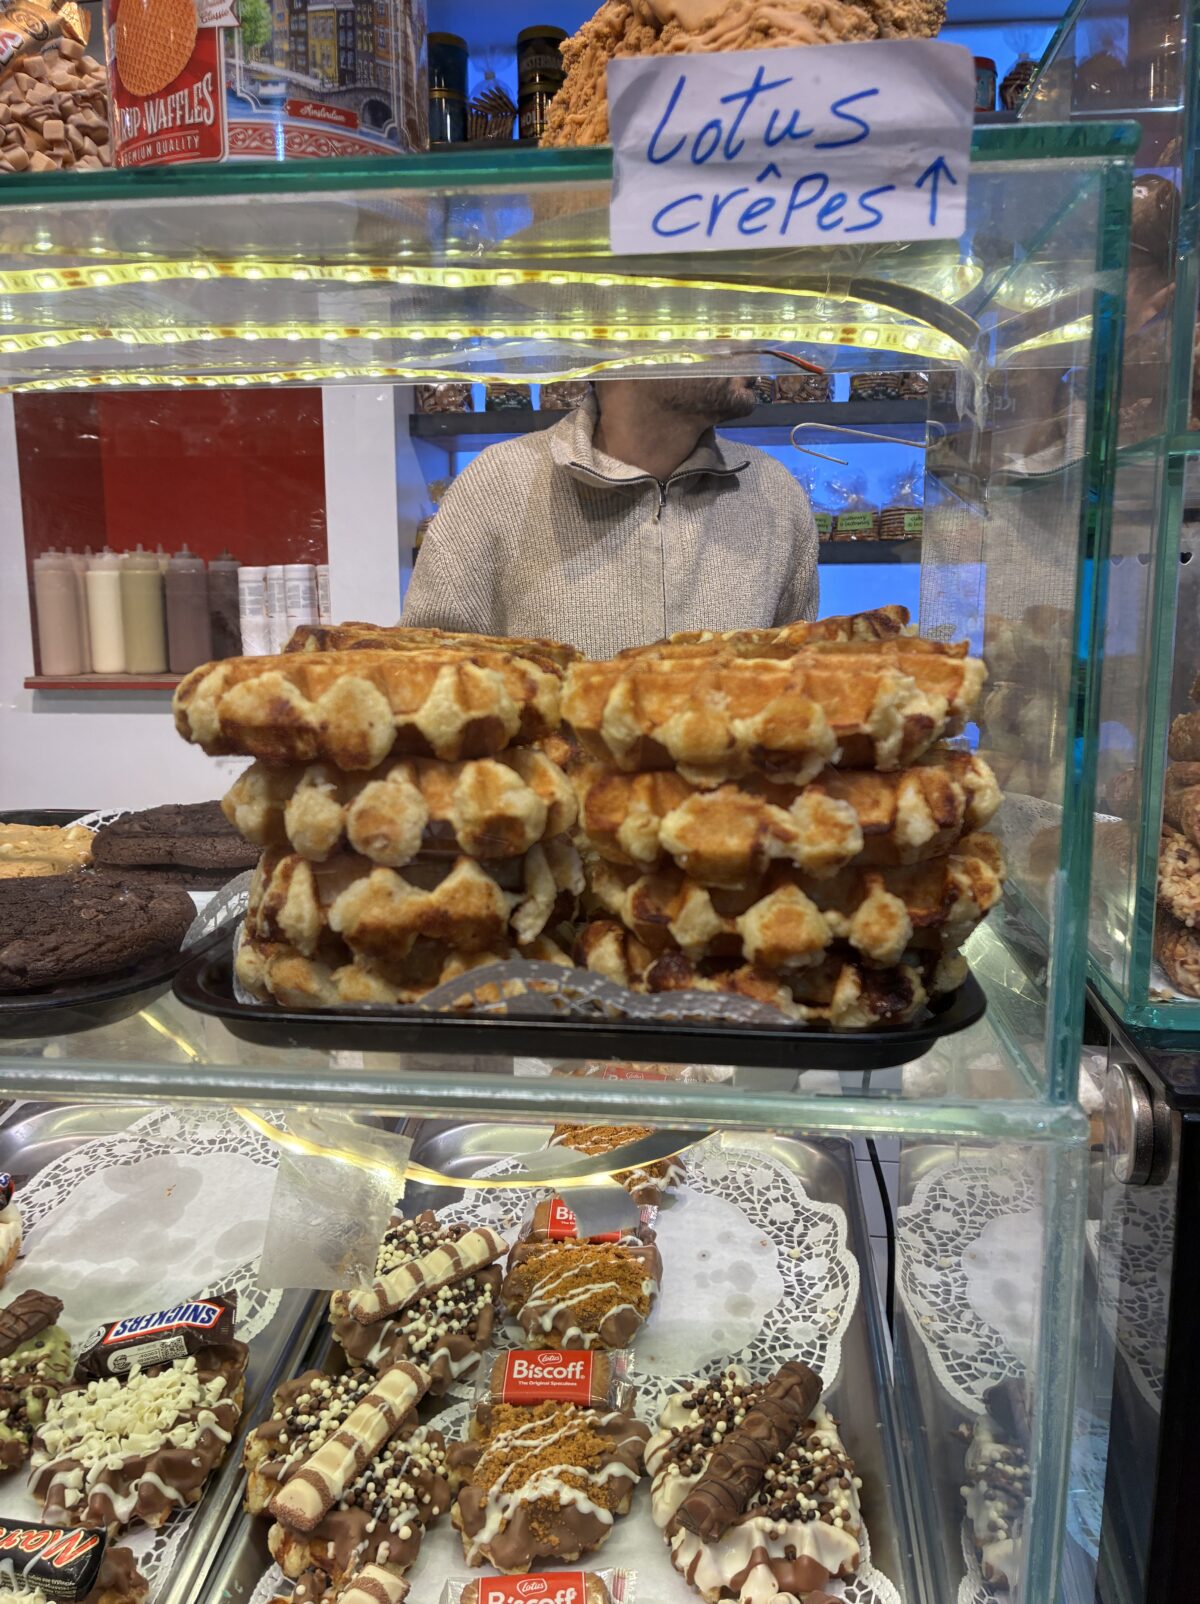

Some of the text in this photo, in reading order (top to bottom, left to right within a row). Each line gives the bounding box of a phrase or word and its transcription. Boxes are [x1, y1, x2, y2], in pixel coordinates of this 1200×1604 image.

[144, 72, 215, 135] WAFFLES
[648, 66, 880, 164] Lotus
[156, 136, 199, 155] QUALITY
[113, 1303, 218, 1337] SNICKERS
[541, 1354, 561, 1363] Lotus
[513, 1359, 585, 1380] Biscoff
[521, 1581, 545, 1592] Lotus
